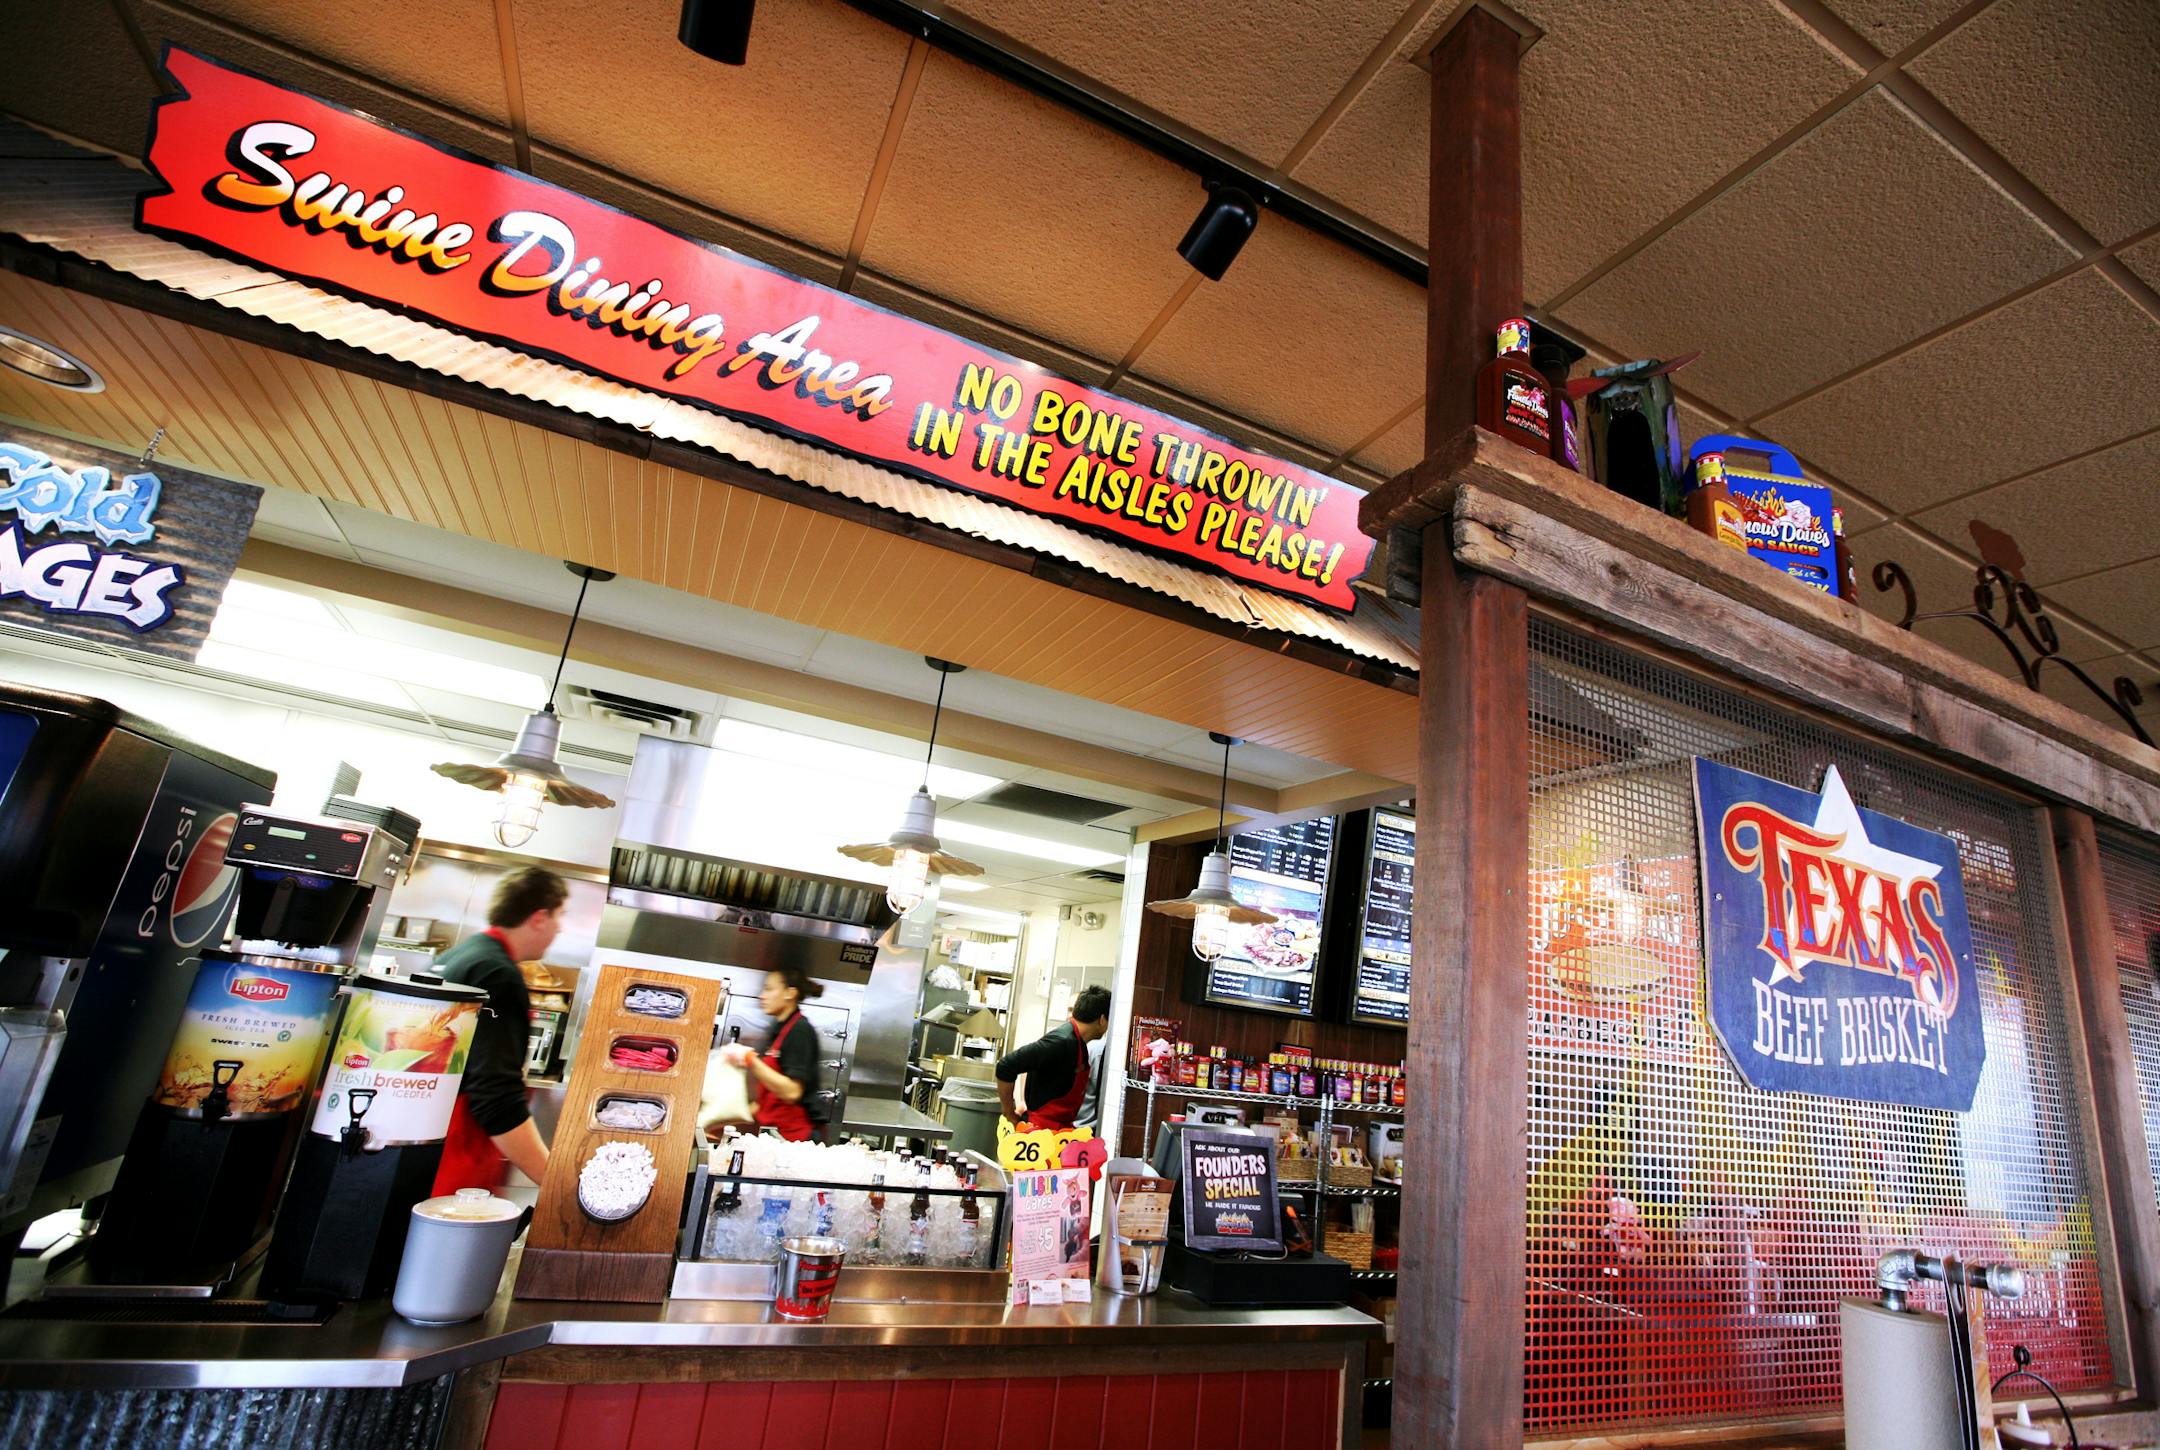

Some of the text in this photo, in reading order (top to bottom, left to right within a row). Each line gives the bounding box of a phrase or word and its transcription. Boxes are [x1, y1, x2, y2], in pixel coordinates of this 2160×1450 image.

[207, 120, 894, 416] Swine Dining Area
[957, 362, 1328, 528] NO BONE THROWIN'
[912, 402, 1346, 586] IN THE AISLES PLEASE!
[1780, 521, 1831, 548] Dave's
[1767, 540, 1820, 557] SAUCE
[138, 806, 197, 937] pepsi
[1721, 802, 1959, 1018] TEXAS
[842, 951, 873, 964] PRIDE
[235, 980, 284, 996] Lipton
[201, 1013, 297, 1029] FRESH BREWED
[1752, 977, 1948, 1076] BEEF BRISKET
[210, 1038, 246, 1046] SWEET
[345, 1057, 369, 1067] Lipton
[334, 1071, 439, 1090] fresh brewed
[1014, 1141, 1040, 1162] 26
[1077, 1151, 1088, 1167] 6
[1207, 1145, 1226, 1153] ABOUT
[1195, 1154, 1266, 1178] FOUNDERS
[1018, 1174, 1059, 1198] WILBUR
[1205, 1175, 1261, 1200] SPECIAL
[1025, 1198, 1053, 1211] cares
